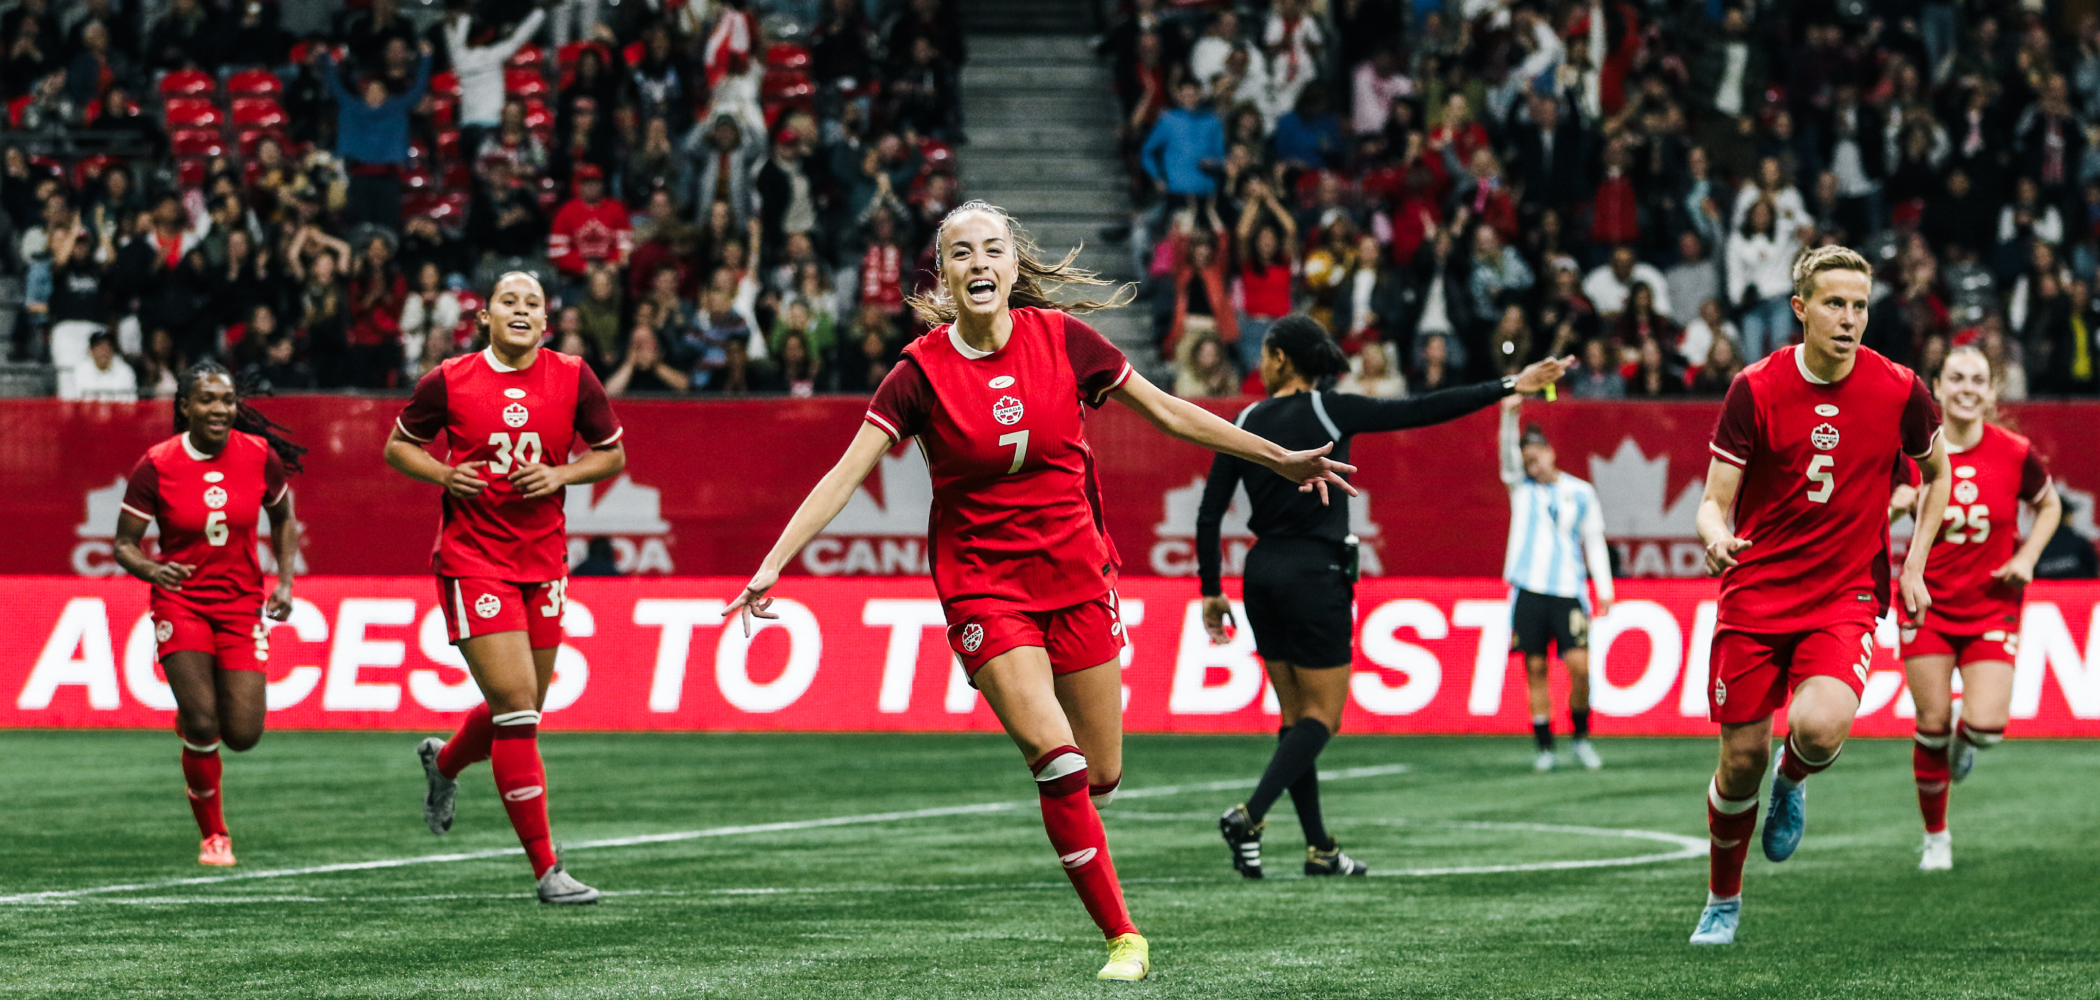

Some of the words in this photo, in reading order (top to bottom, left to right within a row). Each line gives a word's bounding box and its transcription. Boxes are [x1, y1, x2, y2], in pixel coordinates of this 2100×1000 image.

[488, 431, 542, 474] 30
[999, 429, 1029, 474] 7
[1806, 454, 1835, 504] 5
[205, 511, 229, 546] 6
[1944, 504, 1990, 545] 25
[633, 599, 823, 714] TO
[1169, 599, 1512, 716] BST
